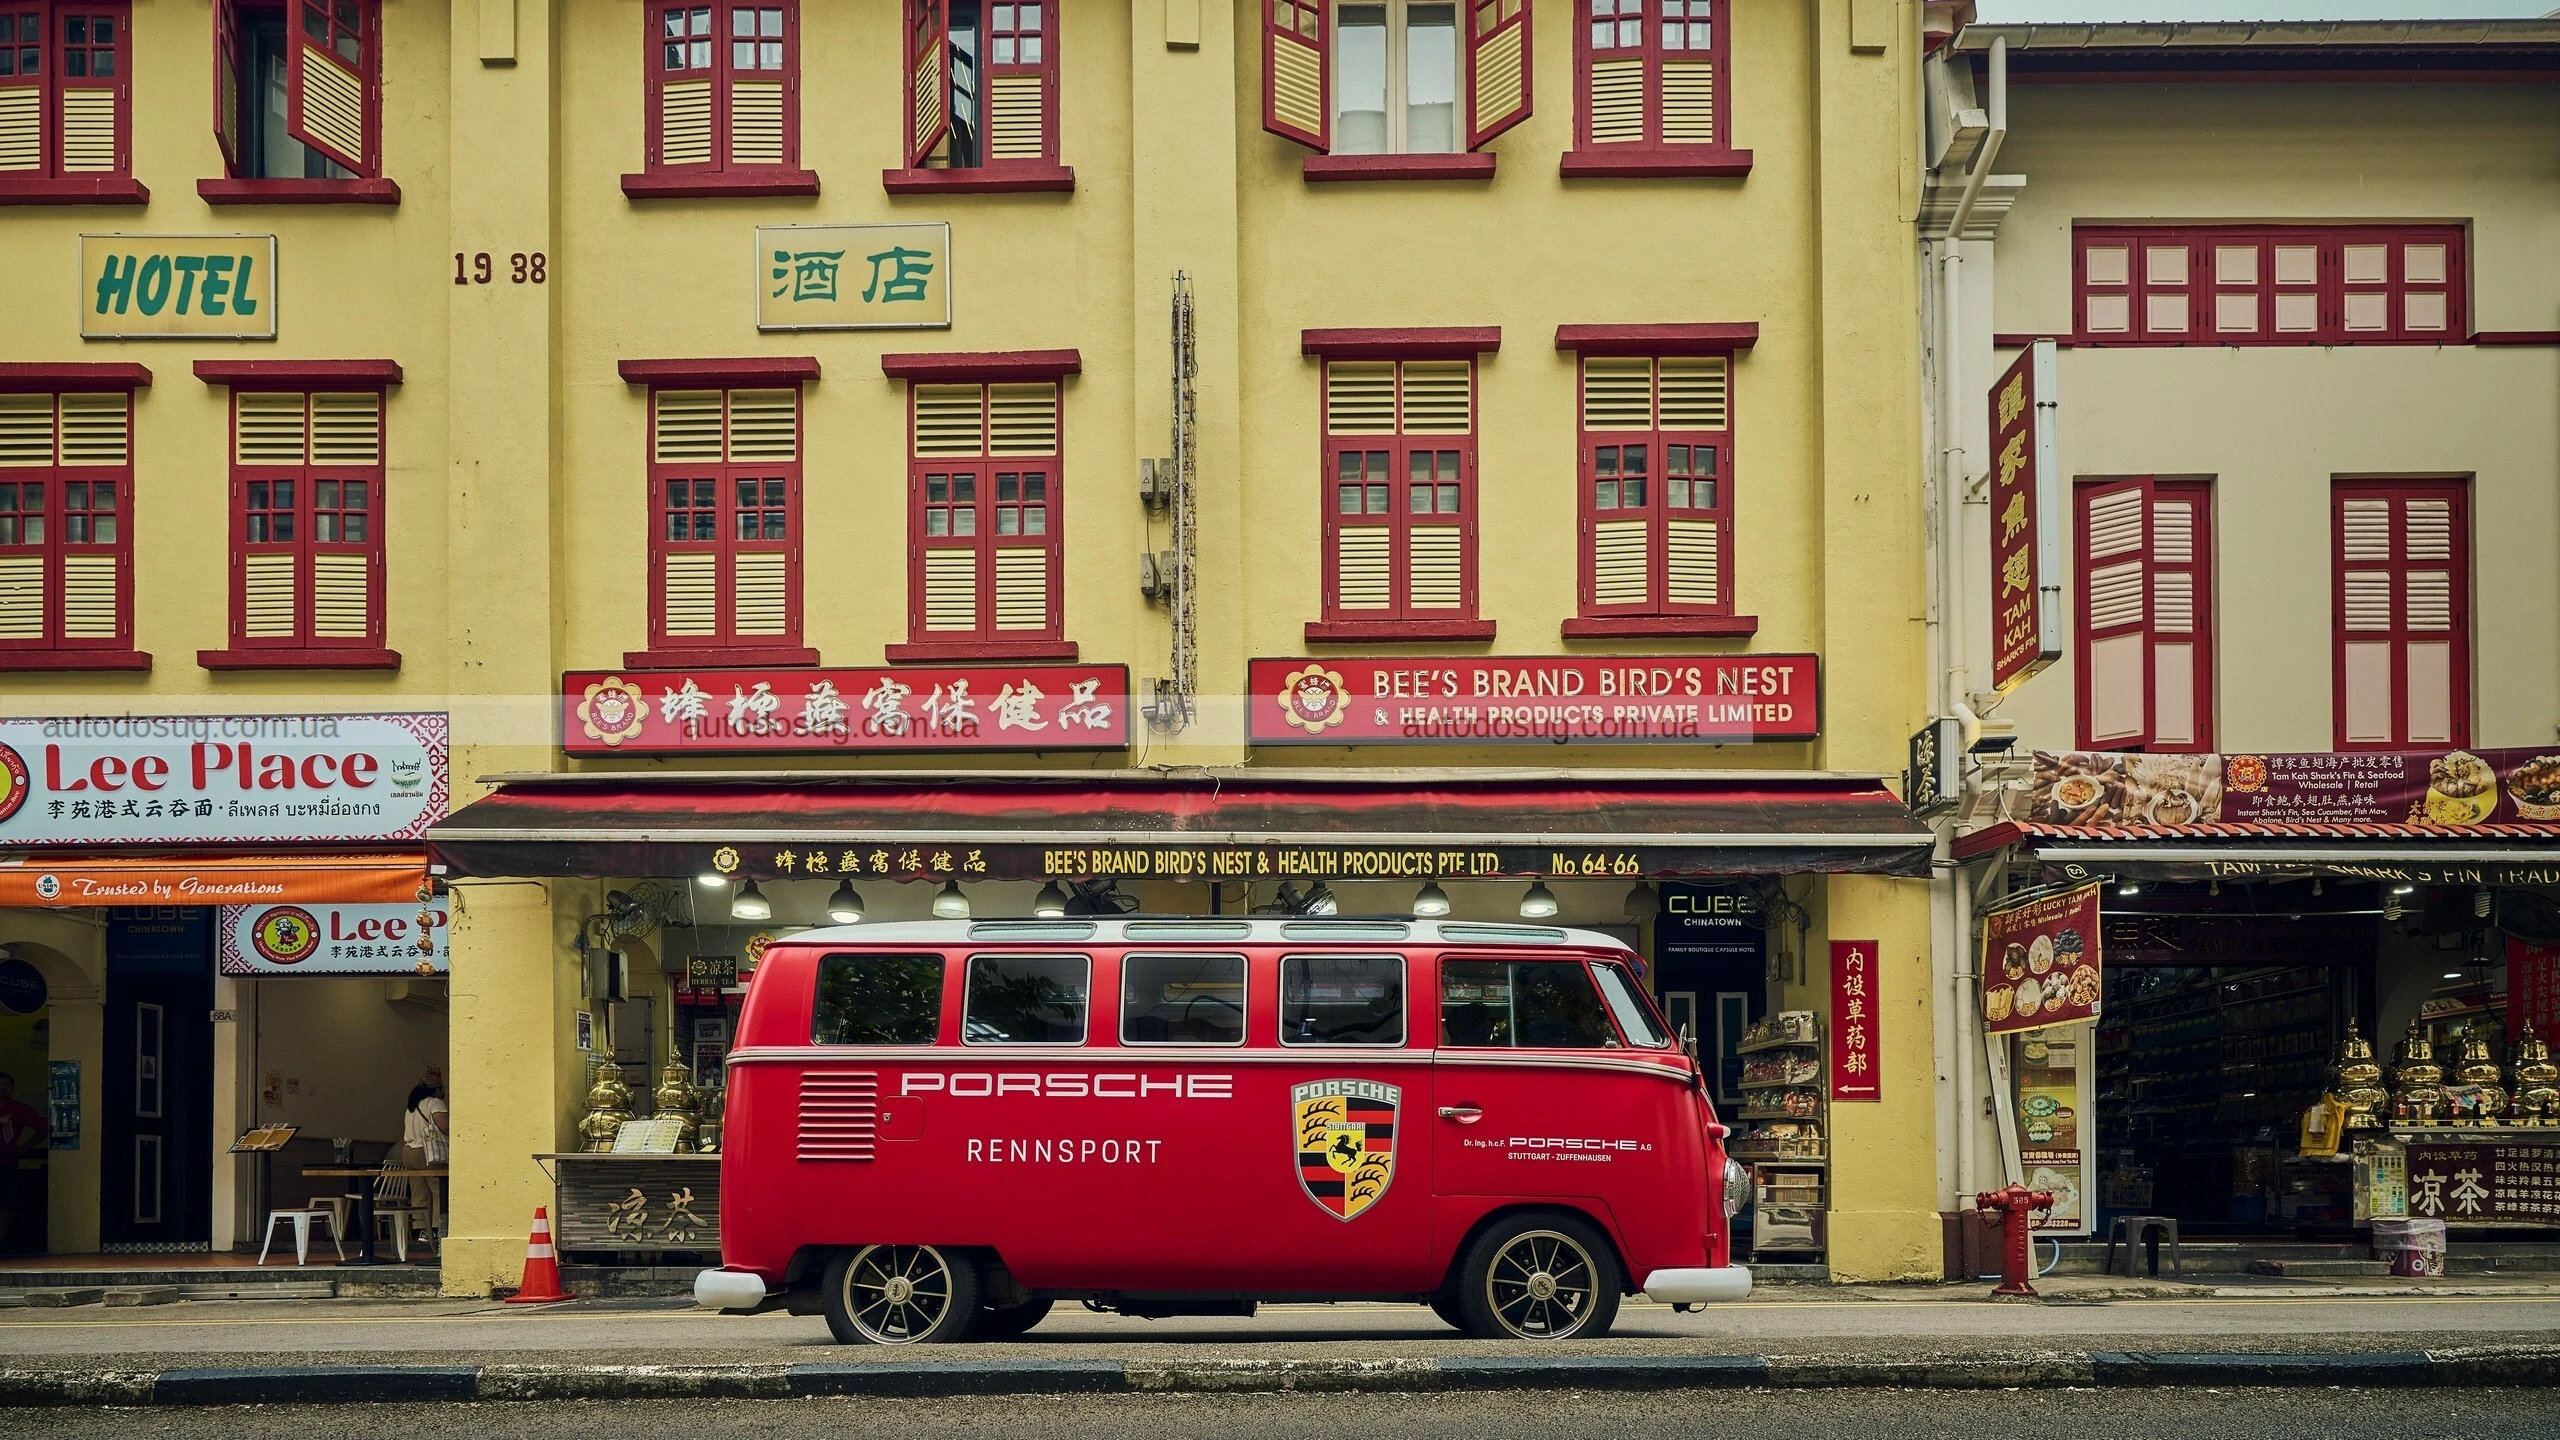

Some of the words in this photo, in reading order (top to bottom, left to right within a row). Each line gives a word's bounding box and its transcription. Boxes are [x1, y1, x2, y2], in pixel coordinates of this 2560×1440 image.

[455, 252, 491, 284] 19
[511, 252, 546, 283] 38
[773, 246, 934, 303] 酒店
[96, 255, 257, 316] HOTEL
[1998, 372, 2031, 599] 譚家魚翅
[2003, 592, 2030, 627] TAM
[2004, 616, 2031, 651] KAH
[1996, 644, 2024, 670] SHARK'S
[2025, 634, 2037, 650] FIN
[1374, 670, 1458, 698] BEE'S
[1474, 669, 1585, 698] BRAND
[1600, 668, 1702, 696] BIRD'S
[1718, 667, 1793, 695] NEST
[1314, 700, 1336, 718] BRAND
[1374, 708, 1389, 725] &
[1400, 706, 1477, 725] HEALTH
[1488, 705, 1604, 724] PRODUCTS
[1614, 705, 1698, 723] PRIVATE
[1709, 704, 1793, 722] LIMITED
[611, 712, 634, 731] BRAND
[45, 743, 169, 792] Lee
[191, 741, 378, 791] Place
[2272, 772, 2289, 780] Tam
[2291, 772, 2308, 780] Kah
[2310, 771, 2341, 780] Shark's
[2343, 771, 2355, 779] Fin
[2367, 770, 2404, 779] Seafood
[2298, 781, 2343, 789] Wholesale
[2354, 780, 2378, 789] Retail
[47, 799, 213, 819] 李苑港式云吞面
[228, 800, 280, 817] ลีเพลส
[2261, 809, 2287, 817] Shark's
[2288, 809, 2300, 817] Fin,
[2317, 808, 2352, 817] Cucumber,
[2369, 808, 2388, 816] Maw,
[2285, 816, 2305, 824] Bird's
[2331, 816, 2351, 825] Many
[1045, 850, 1087, 874] BEE'S
[1092, 851, 1149, 874] BRAND
[1155, 851, 1206, 874] BIRD'S
[1213, 851, 1252, 874] NEST
[1257, 851, 1270, 874] &
[1278, 851, 1337, 874] HEALTH
[1343, 851, 1433, 875] PRODUCTS
[1438, 852, 1464, 874] PTE
[1470, 852, 1499, 874] LTD
[72, 878, 148, 896] Trusted
[153, 879, 172, 899] by
[178, 877, 283, 896] Generations
[112, 906, 199, 920] CUBE
[2043, 898, 2066, 911] LUCKY
[331, 911, 408, 941] Lee
[1684, 918, 1742, 927] CHINATOWN
[2037, 911, 2063, 925] Wholesale
[127, 925, 185, 933] CHINATOWN
[213, 1011, 232, 1021] 68A
[1842, 947, 1868, 1077] 内设草药部
[901, 1073, 1233, 1099] PORSCHE
[1294, 1080, 1399, 1103] PORSCHE
[967, 1139, 1162, 1164] RENNSPORT
[1463, 1139, 1473, 1147] Dr.
[1474, 1139, 1487, 1148] Ing.
[1509, 1137, 1637, 1150] PORSCHE
[1508, 1152, 1550, 1160] STUTTGART
[1555, 1153, 1611, 1162] ZUFFENHAUSEN
[2418, 1151, 2478, 1161] 内设草药
[2411, 1168, 2490, 1216] 凉茶
